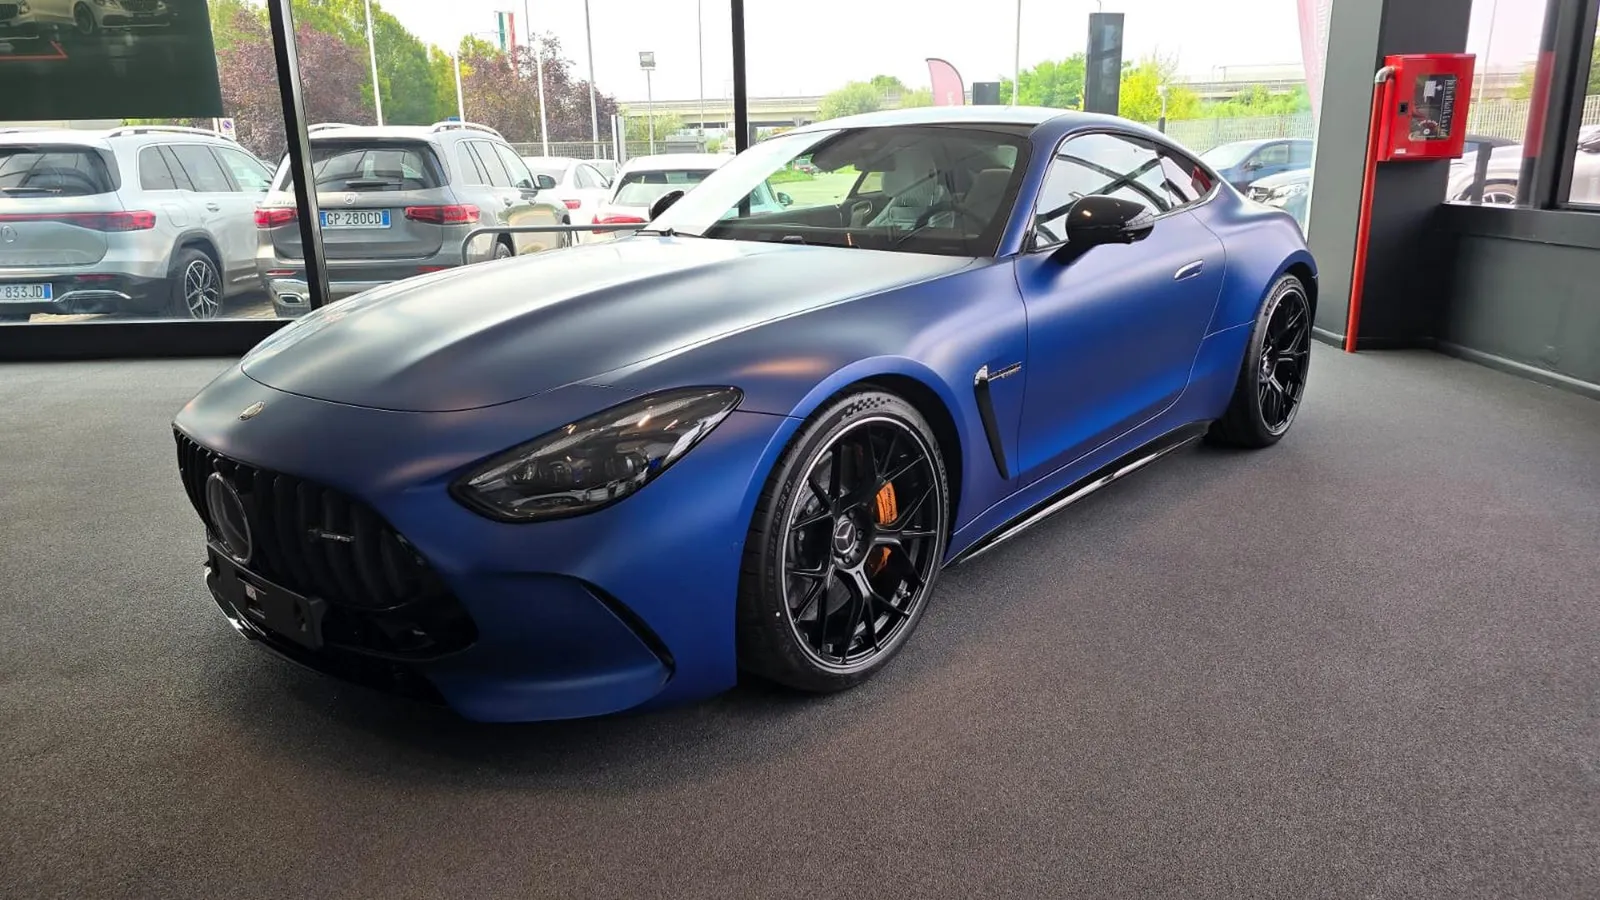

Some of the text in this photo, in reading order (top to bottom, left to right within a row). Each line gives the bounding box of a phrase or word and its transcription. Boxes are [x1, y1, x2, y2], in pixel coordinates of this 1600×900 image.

[327, 212, 341, 225] GP
[345, 212, 381, 224] 280CD
[5, 285, 43, 298] 833JD
